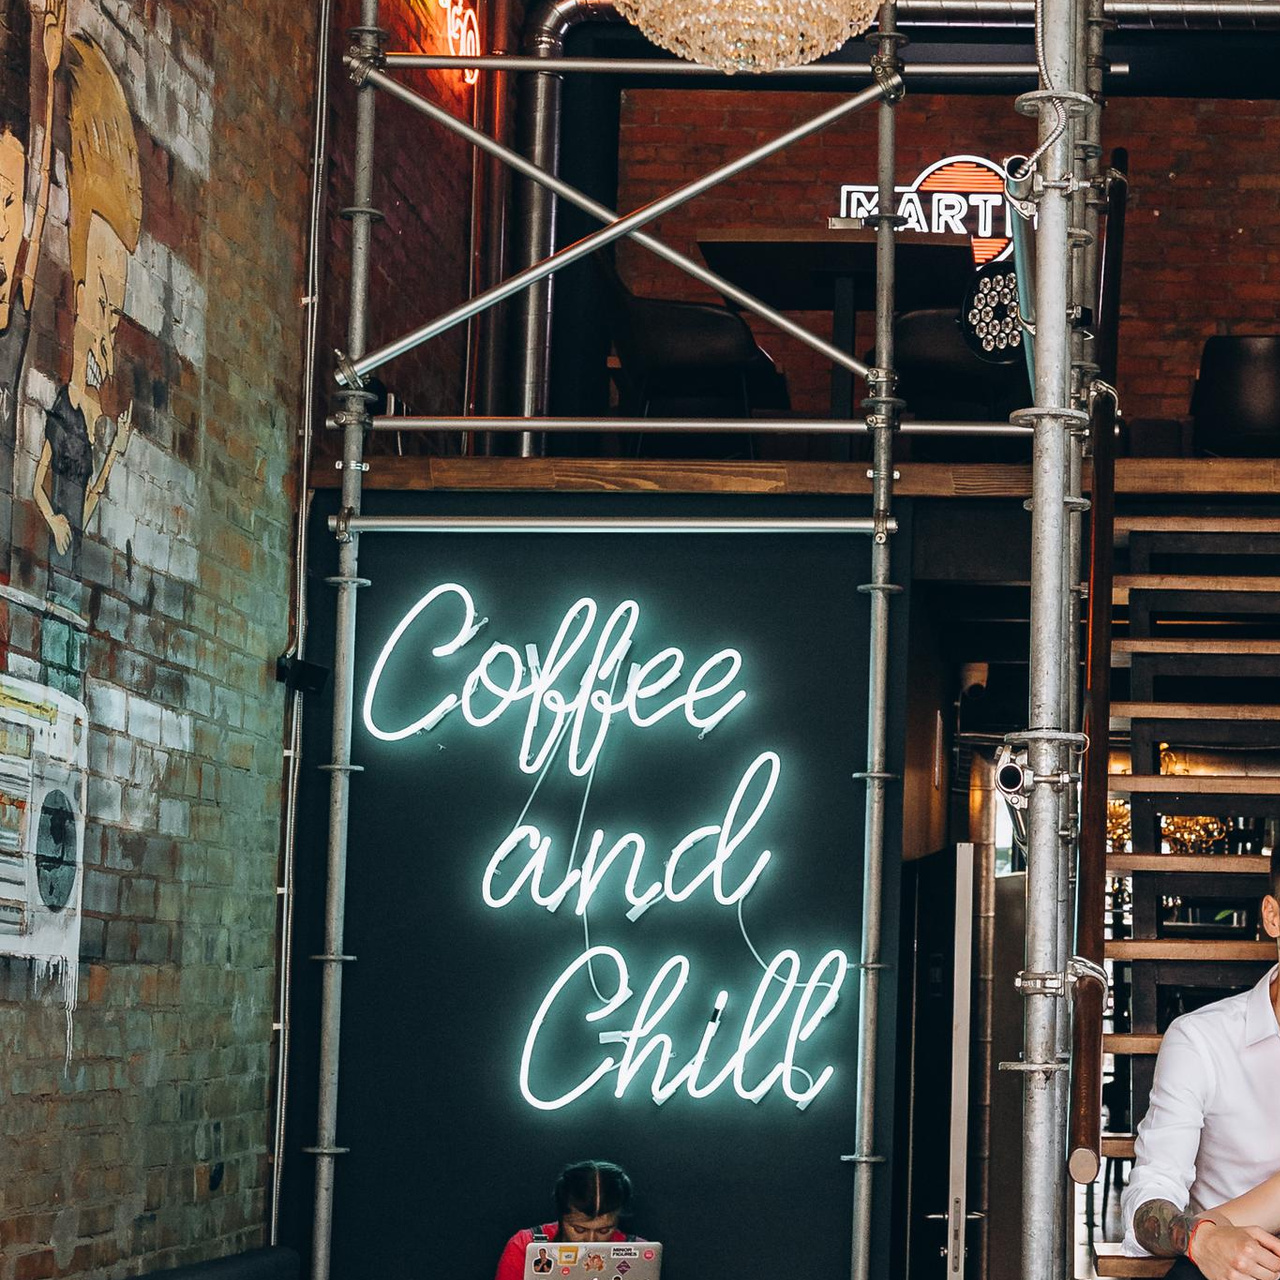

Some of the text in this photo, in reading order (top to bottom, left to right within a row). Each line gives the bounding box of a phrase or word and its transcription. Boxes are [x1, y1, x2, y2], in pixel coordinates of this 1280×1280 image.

[362, 582, 747, 776] Coffee
[482, 751, 781, 916] and
[519, 945, 848, 1111] Chill
